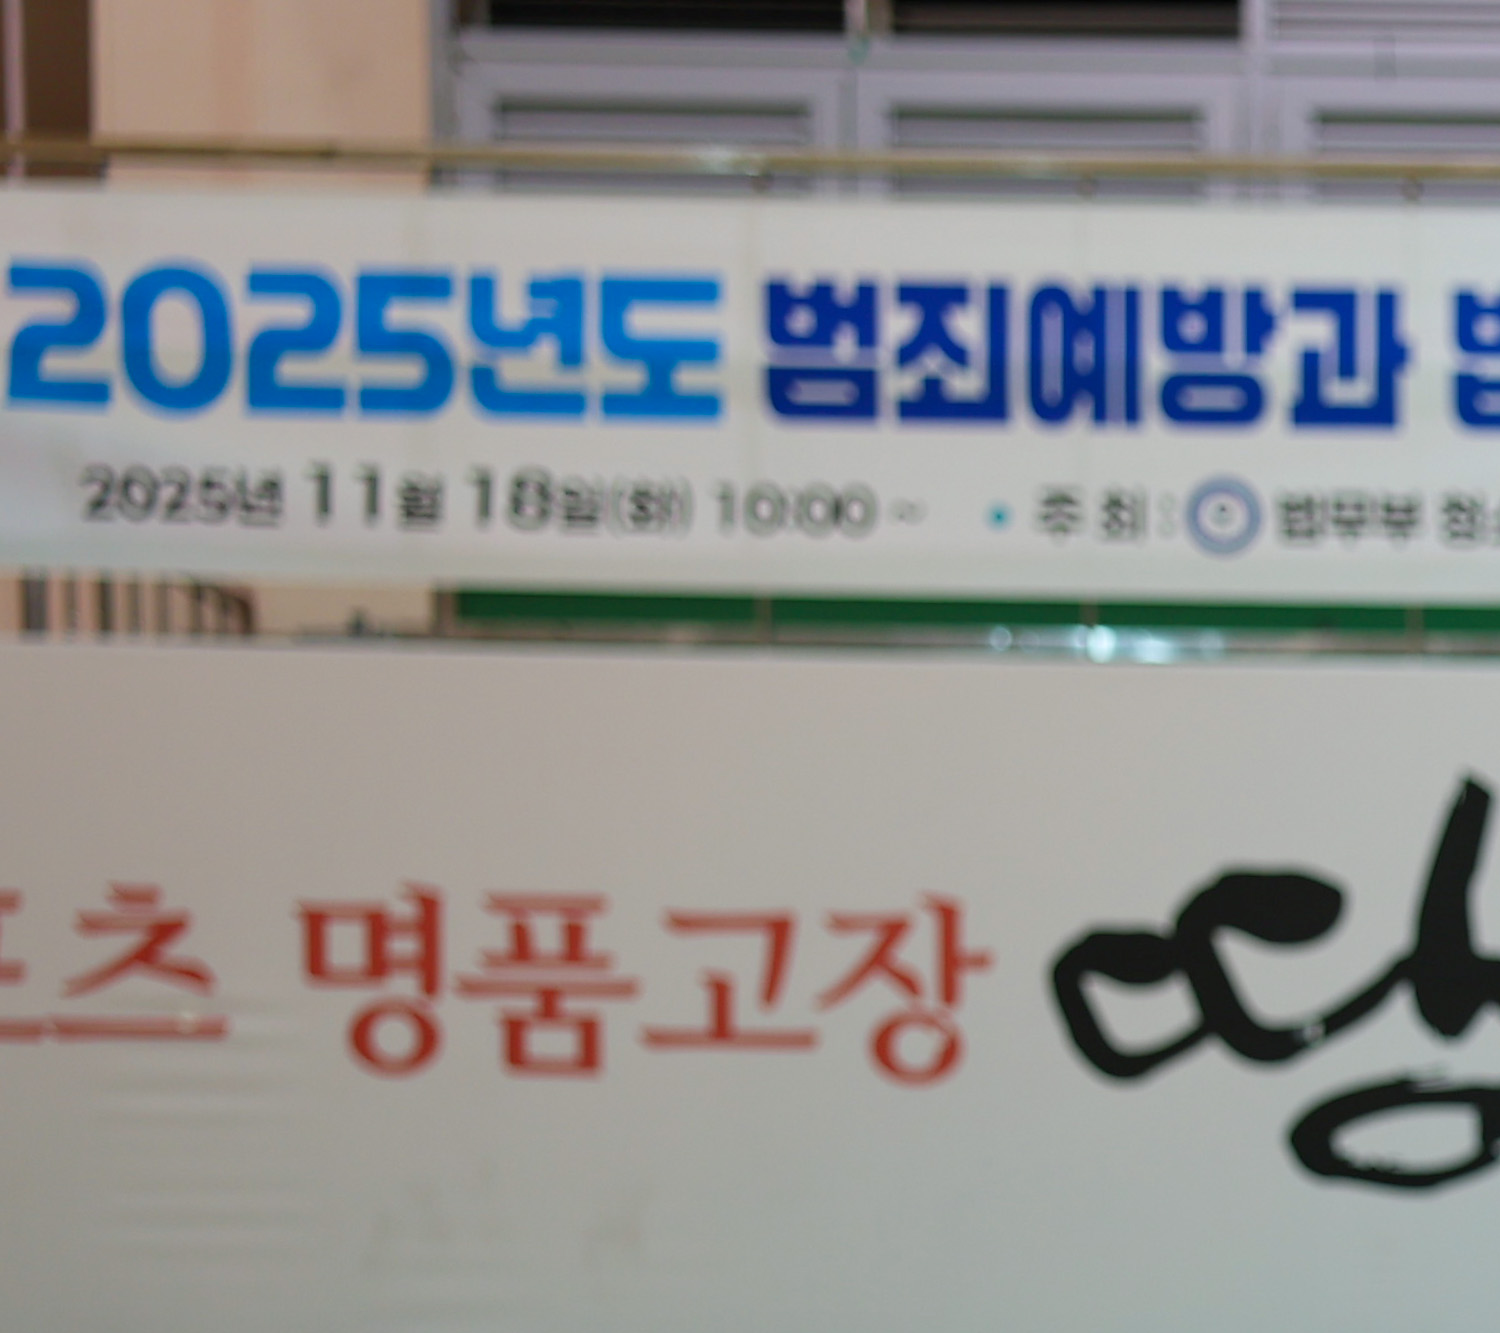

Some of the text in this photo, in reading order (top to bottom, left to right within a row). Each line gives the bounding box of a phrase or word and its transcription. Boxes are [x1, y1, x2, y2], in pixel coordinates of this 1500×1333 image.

[6, 260, 726, 424] 2025년도
[761, 278, 1413, 433] 범죄예방과
[80, 465, 284, 528] 2025년
[312, 465, 445, 532] 11월
[717, 483, 879, 537] 10:00
[1277, 494, 1423, 544] 법무부
[297, 885, 991, 1085] 명품고장
